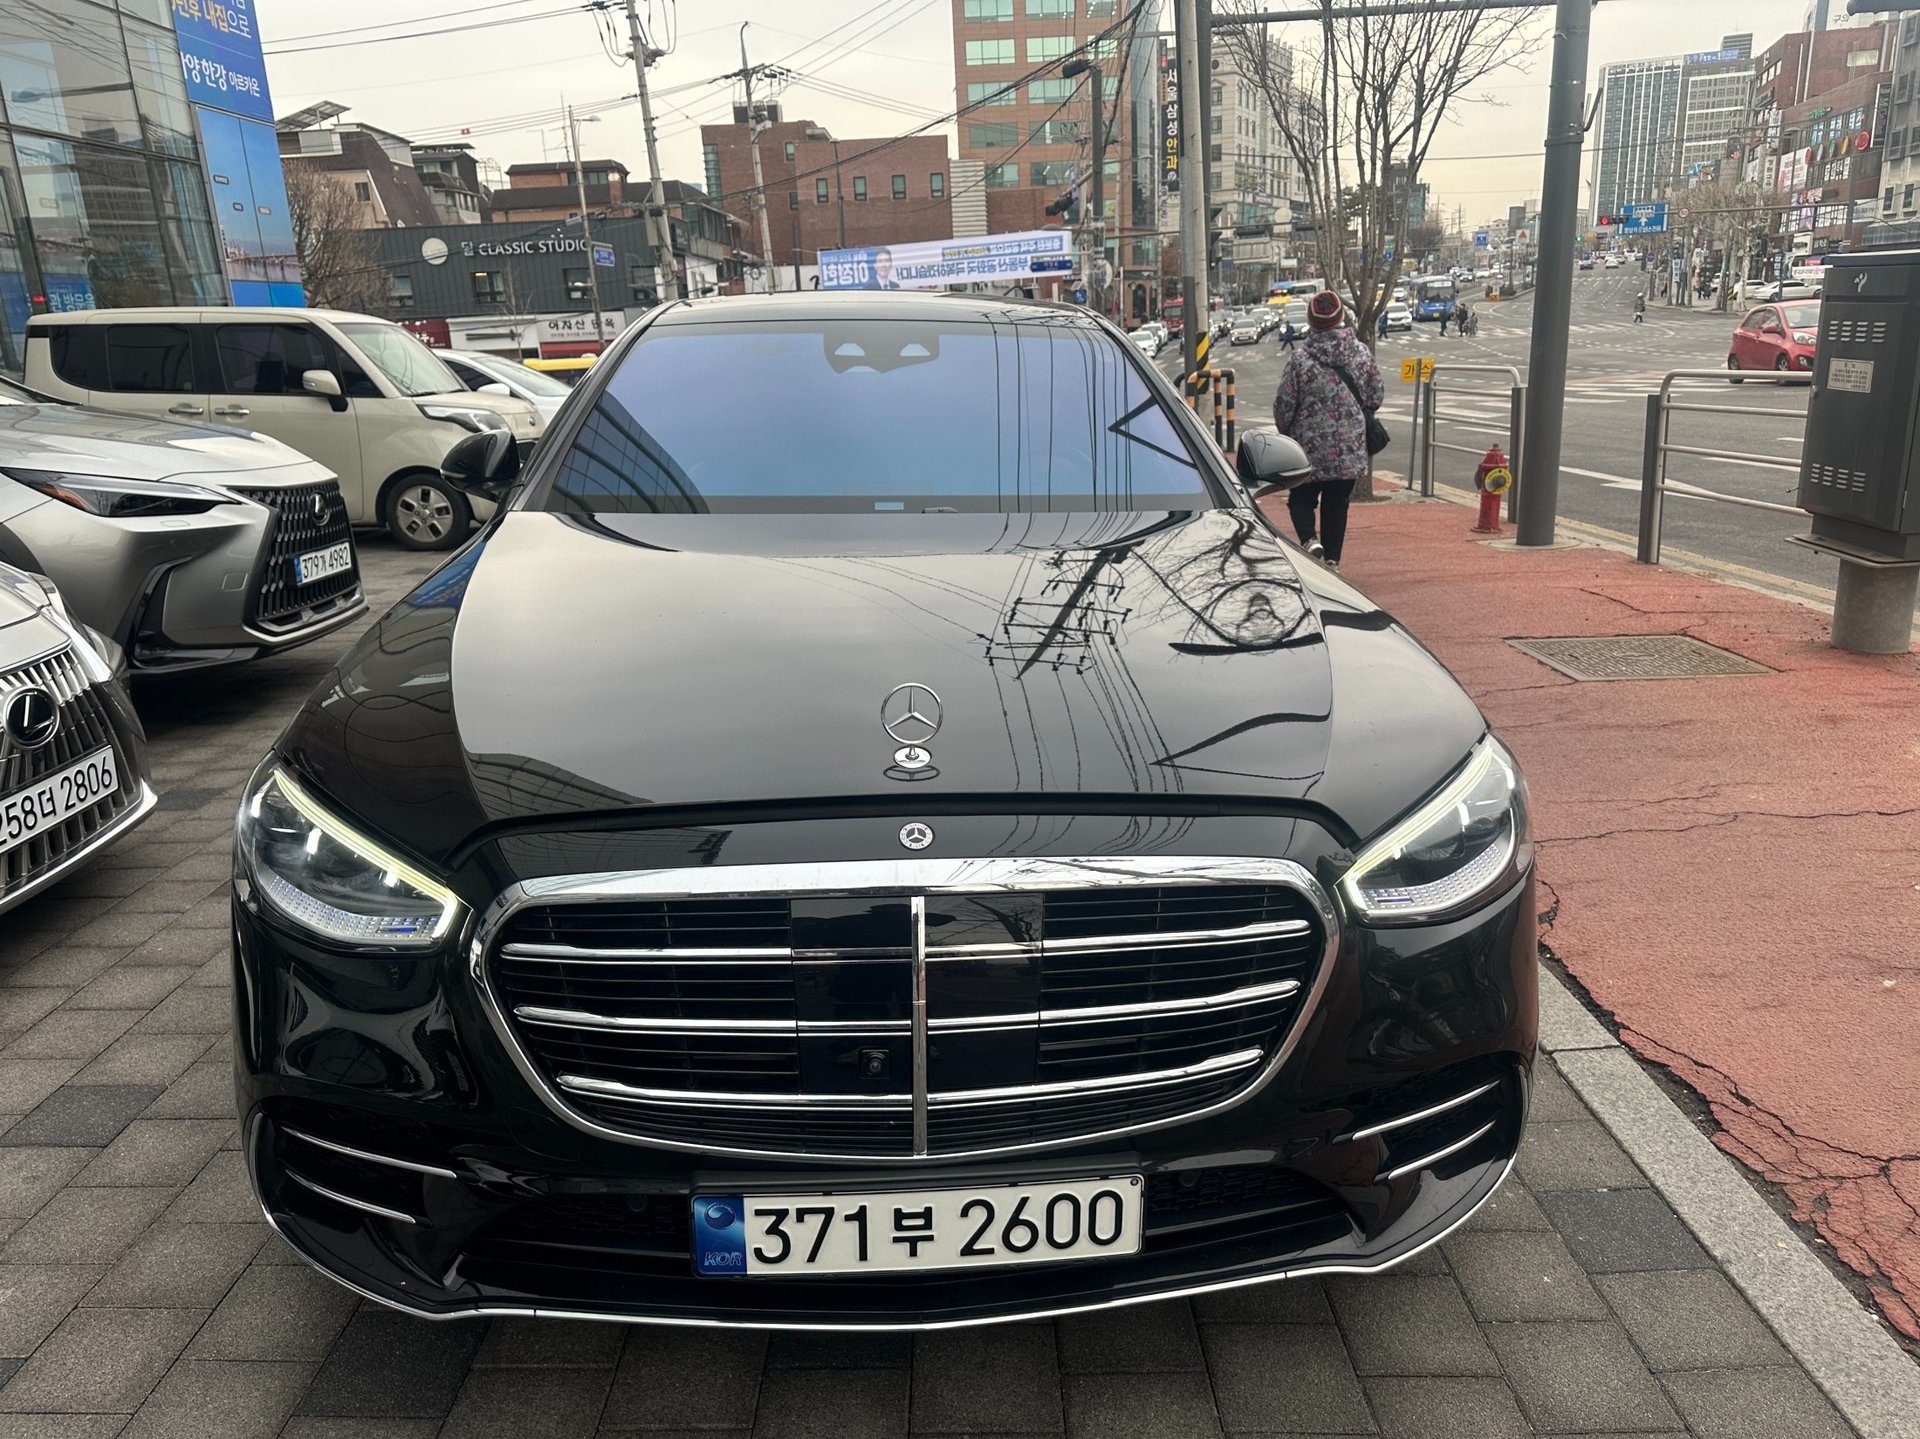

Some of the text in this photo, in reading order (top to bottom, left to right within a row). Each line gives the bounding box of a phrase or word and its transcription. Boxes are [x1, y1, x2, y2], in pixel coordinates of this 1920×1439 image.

[1166, 68, 1178, 171] 서울삼성안과
[478, 240, 535, 257] CLASSIC
[328, 546, 350, 570] 4982
[60, 756, 113, 812] 2806
[753, 1188, 1124, 1264] 371부 2600
[703, 1251, 742, 1267] KOR
